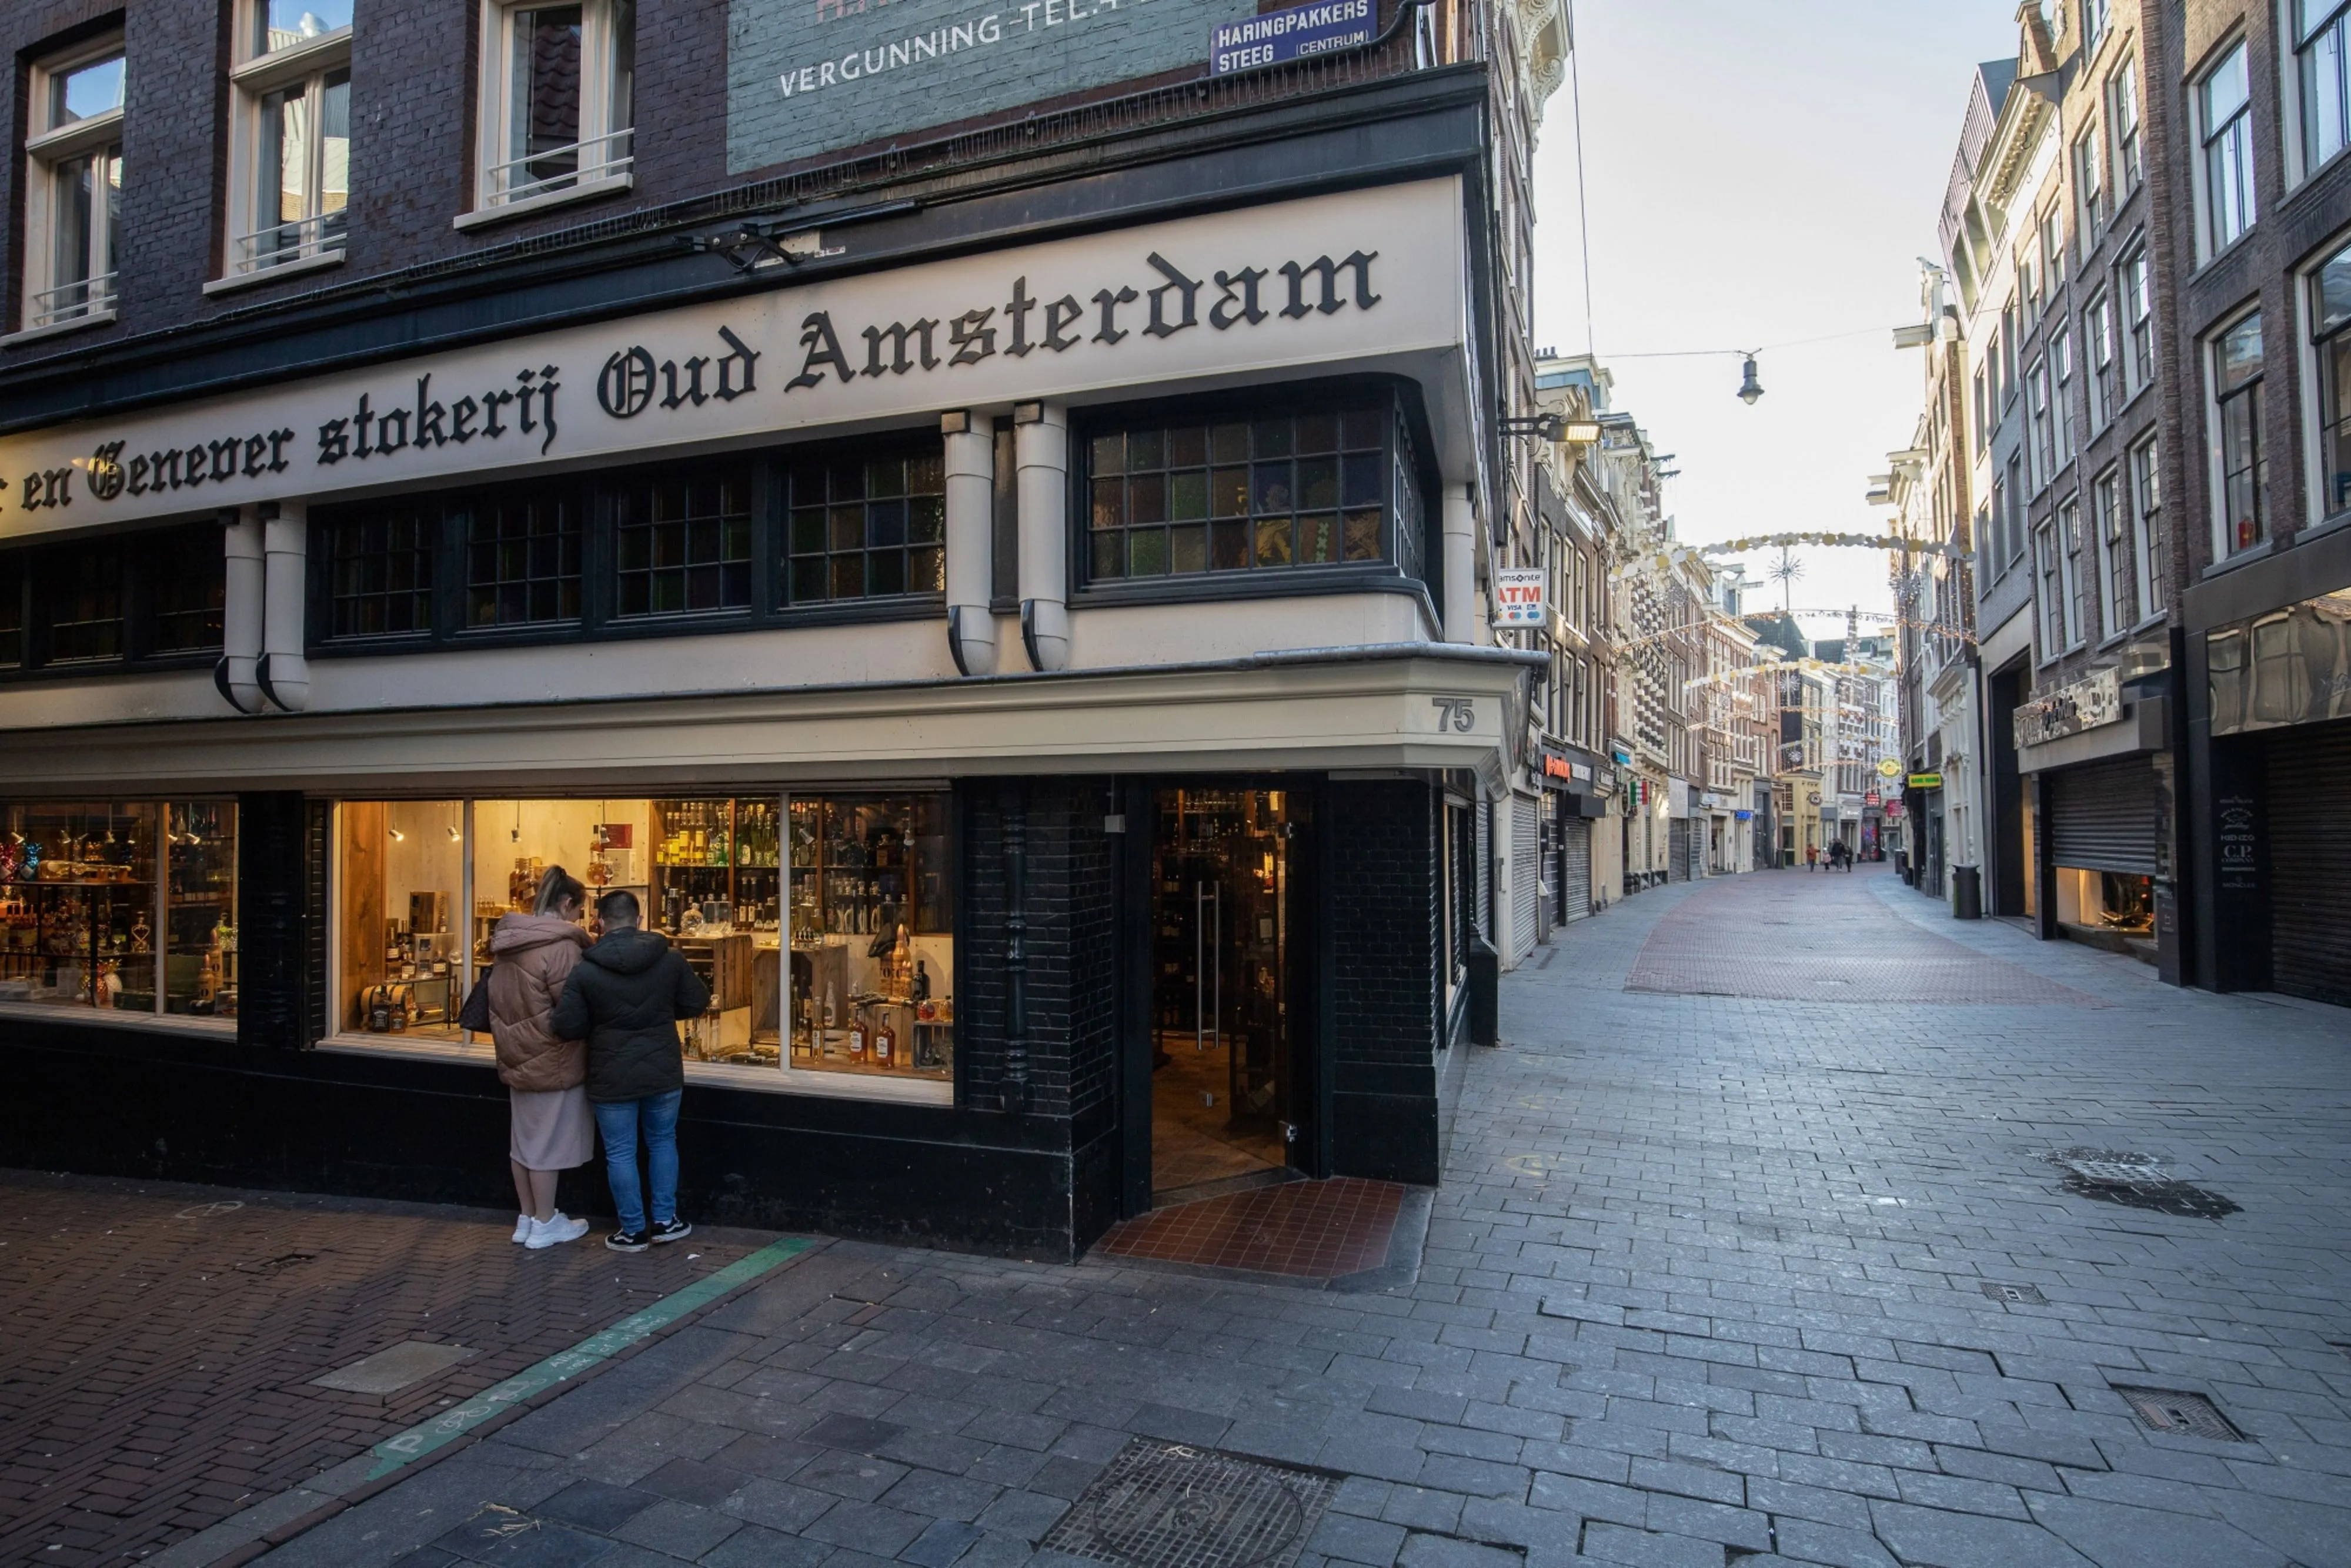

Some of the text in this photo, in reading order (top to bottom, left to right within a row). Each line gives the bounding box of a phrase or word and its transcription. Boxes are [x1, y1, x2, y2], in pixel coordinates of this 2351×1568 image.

[1218, 0, 1368, 48] HARINGPAKKERS
[1219, 29, 1369, 72] STEEG (CENTRUM)
[21, 250, 1382, 512] en Genever stokerij Oud Amsterdam
[1499, 574, 1541, 583] amsonite
[1499, 586, 1541, 603] ATM
[1432, 697, 1475, 732] 75
[384, 1435, 425, 1453] P
